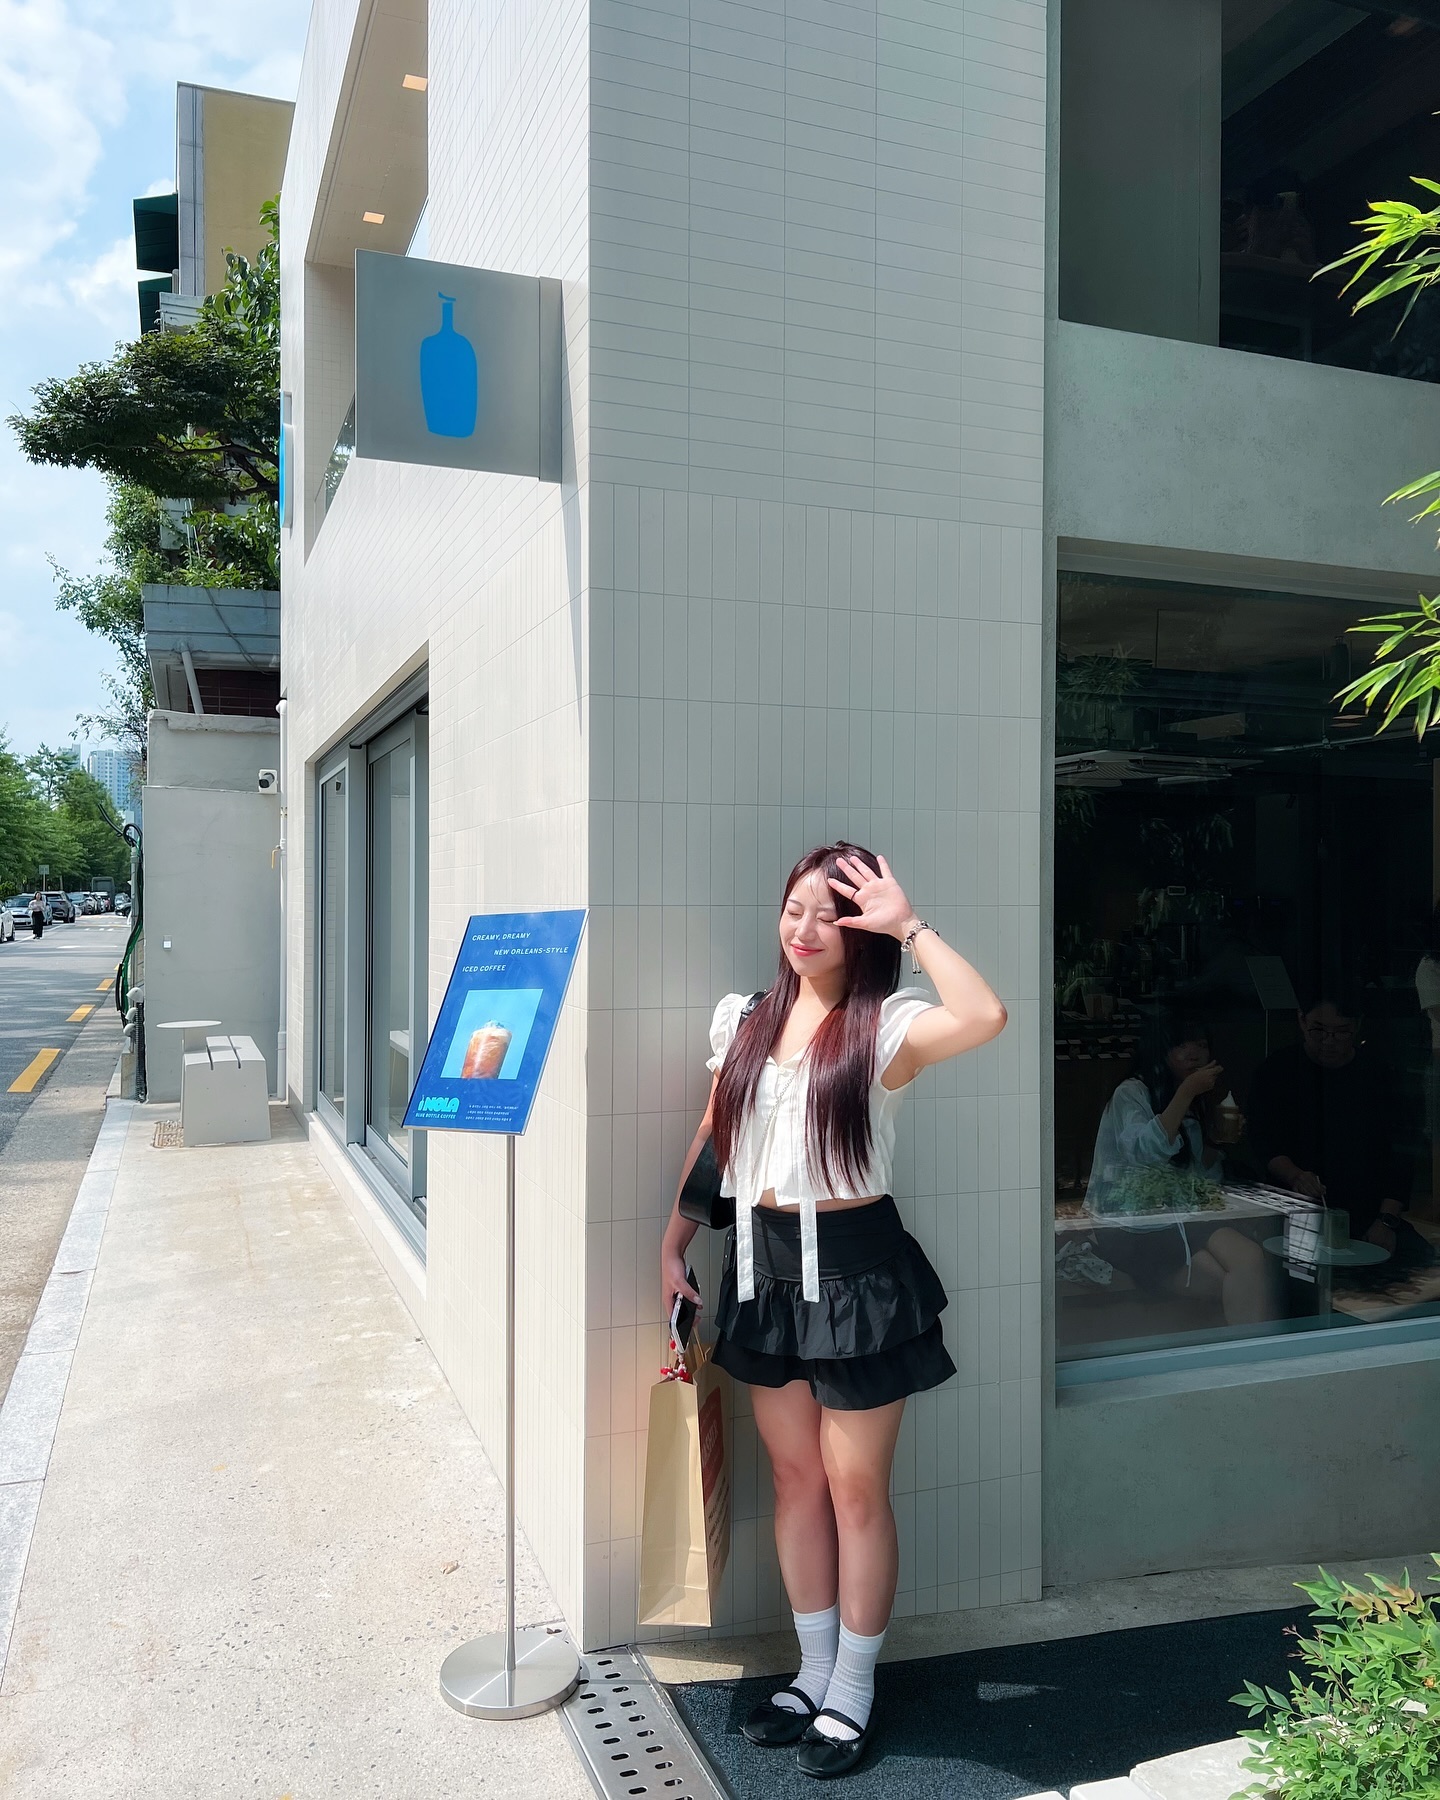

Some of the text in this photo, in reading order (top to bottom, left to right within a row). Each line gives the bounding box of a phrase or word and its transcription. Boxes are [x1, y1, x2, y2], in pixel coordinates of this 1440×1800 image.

[472, 932, 531, 942] CREAMY, DREAMY
[510, 946, 569, 955] ORLEANS-STYLE
[462, 964, 506, 973] ICED COFFEE
